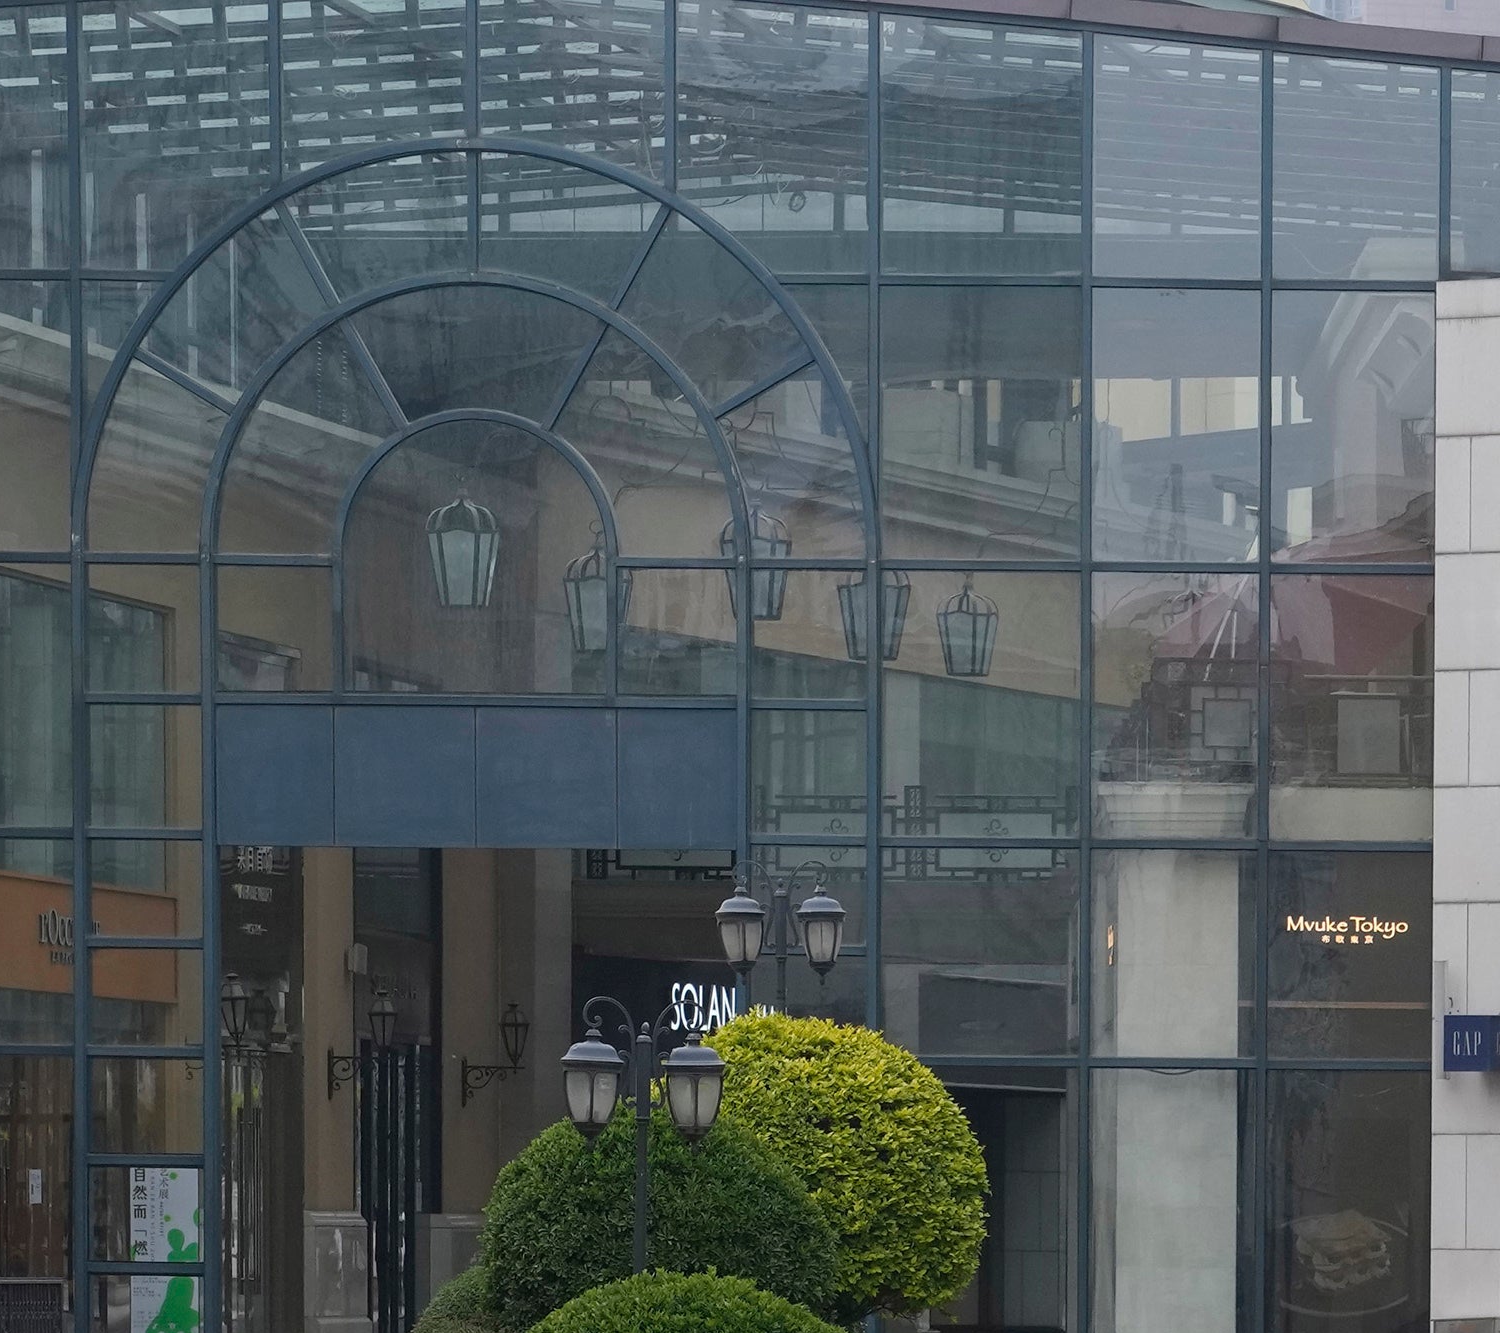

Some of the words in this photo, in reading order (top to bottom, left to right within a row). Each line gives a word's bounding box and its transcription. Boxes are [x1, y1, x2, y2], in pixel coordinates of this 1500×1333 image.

[1286, 915, 1348, 932] Mvuke
[1349, 916, 1409, 939] Tokyo
[1453, 1030, 1482, 1056] GAP
